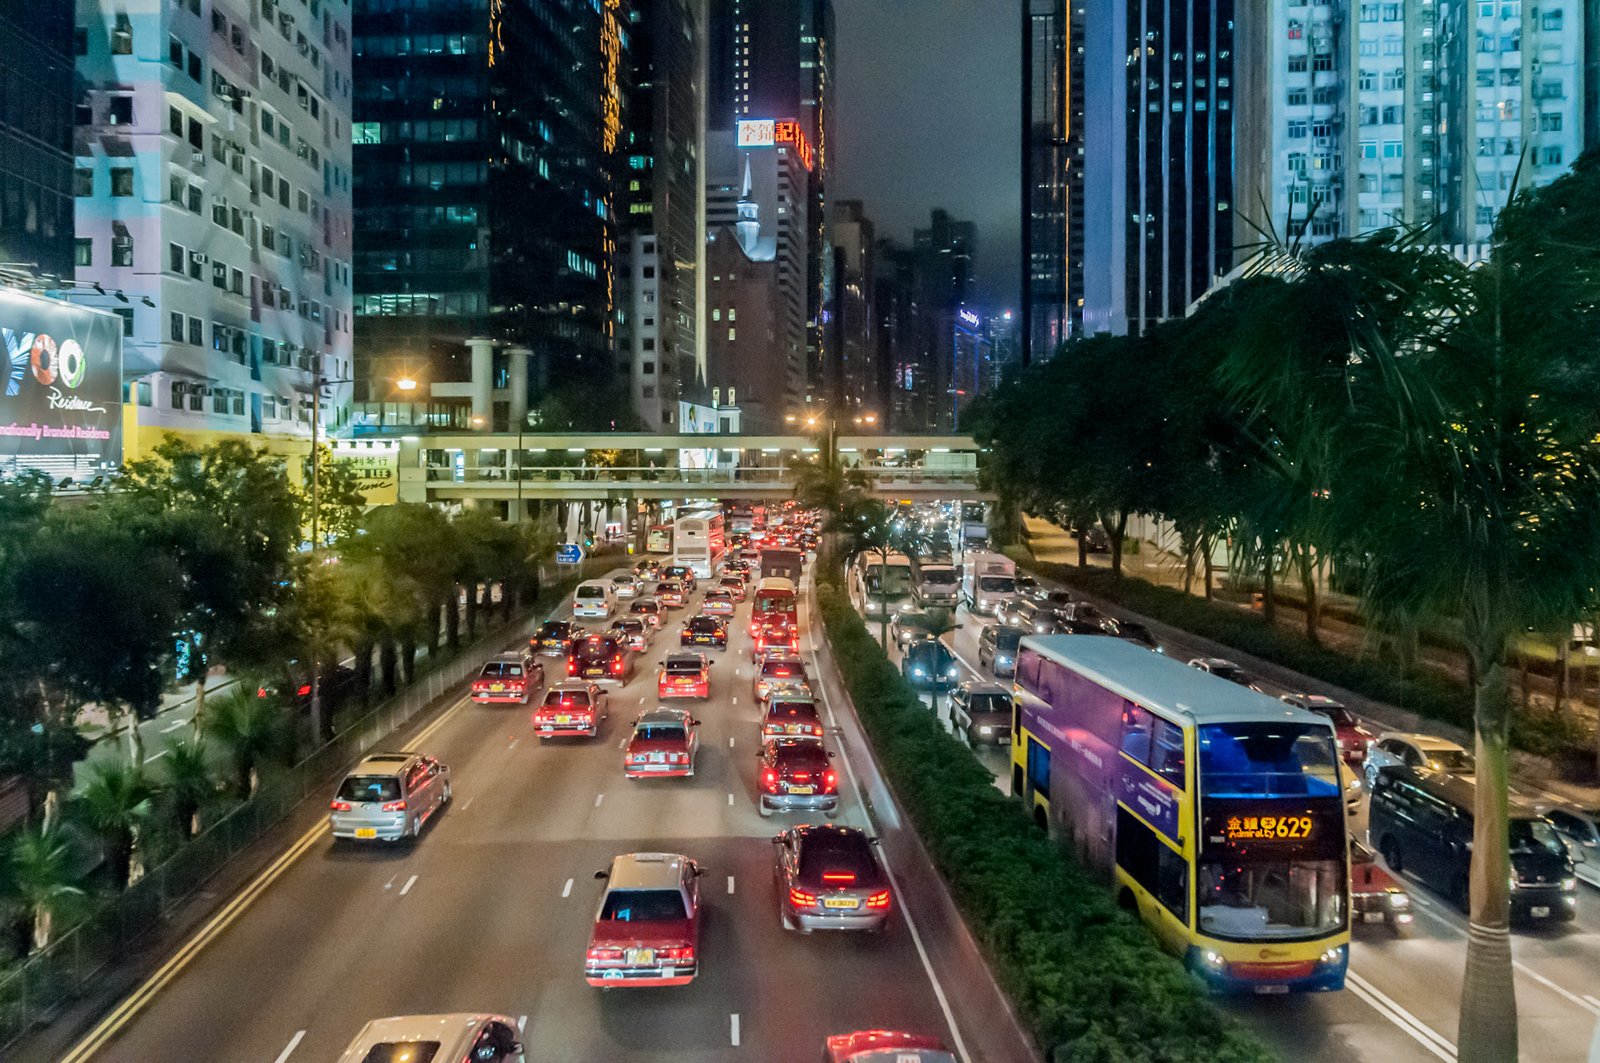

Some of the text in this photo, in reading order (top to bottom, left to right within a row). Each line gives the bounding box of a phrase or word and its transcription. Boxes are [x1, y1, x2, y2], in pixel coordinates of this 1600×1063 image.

[47, 386, 107, 413] Residence
[42, 424, 76, 438] Branded
[76, 426, 110, 439] Residence
[373, 469, 390, 478] LEE
[1229, 829, 1275, 839] Admiralty
[1276, 817, 1312, 838] 629
